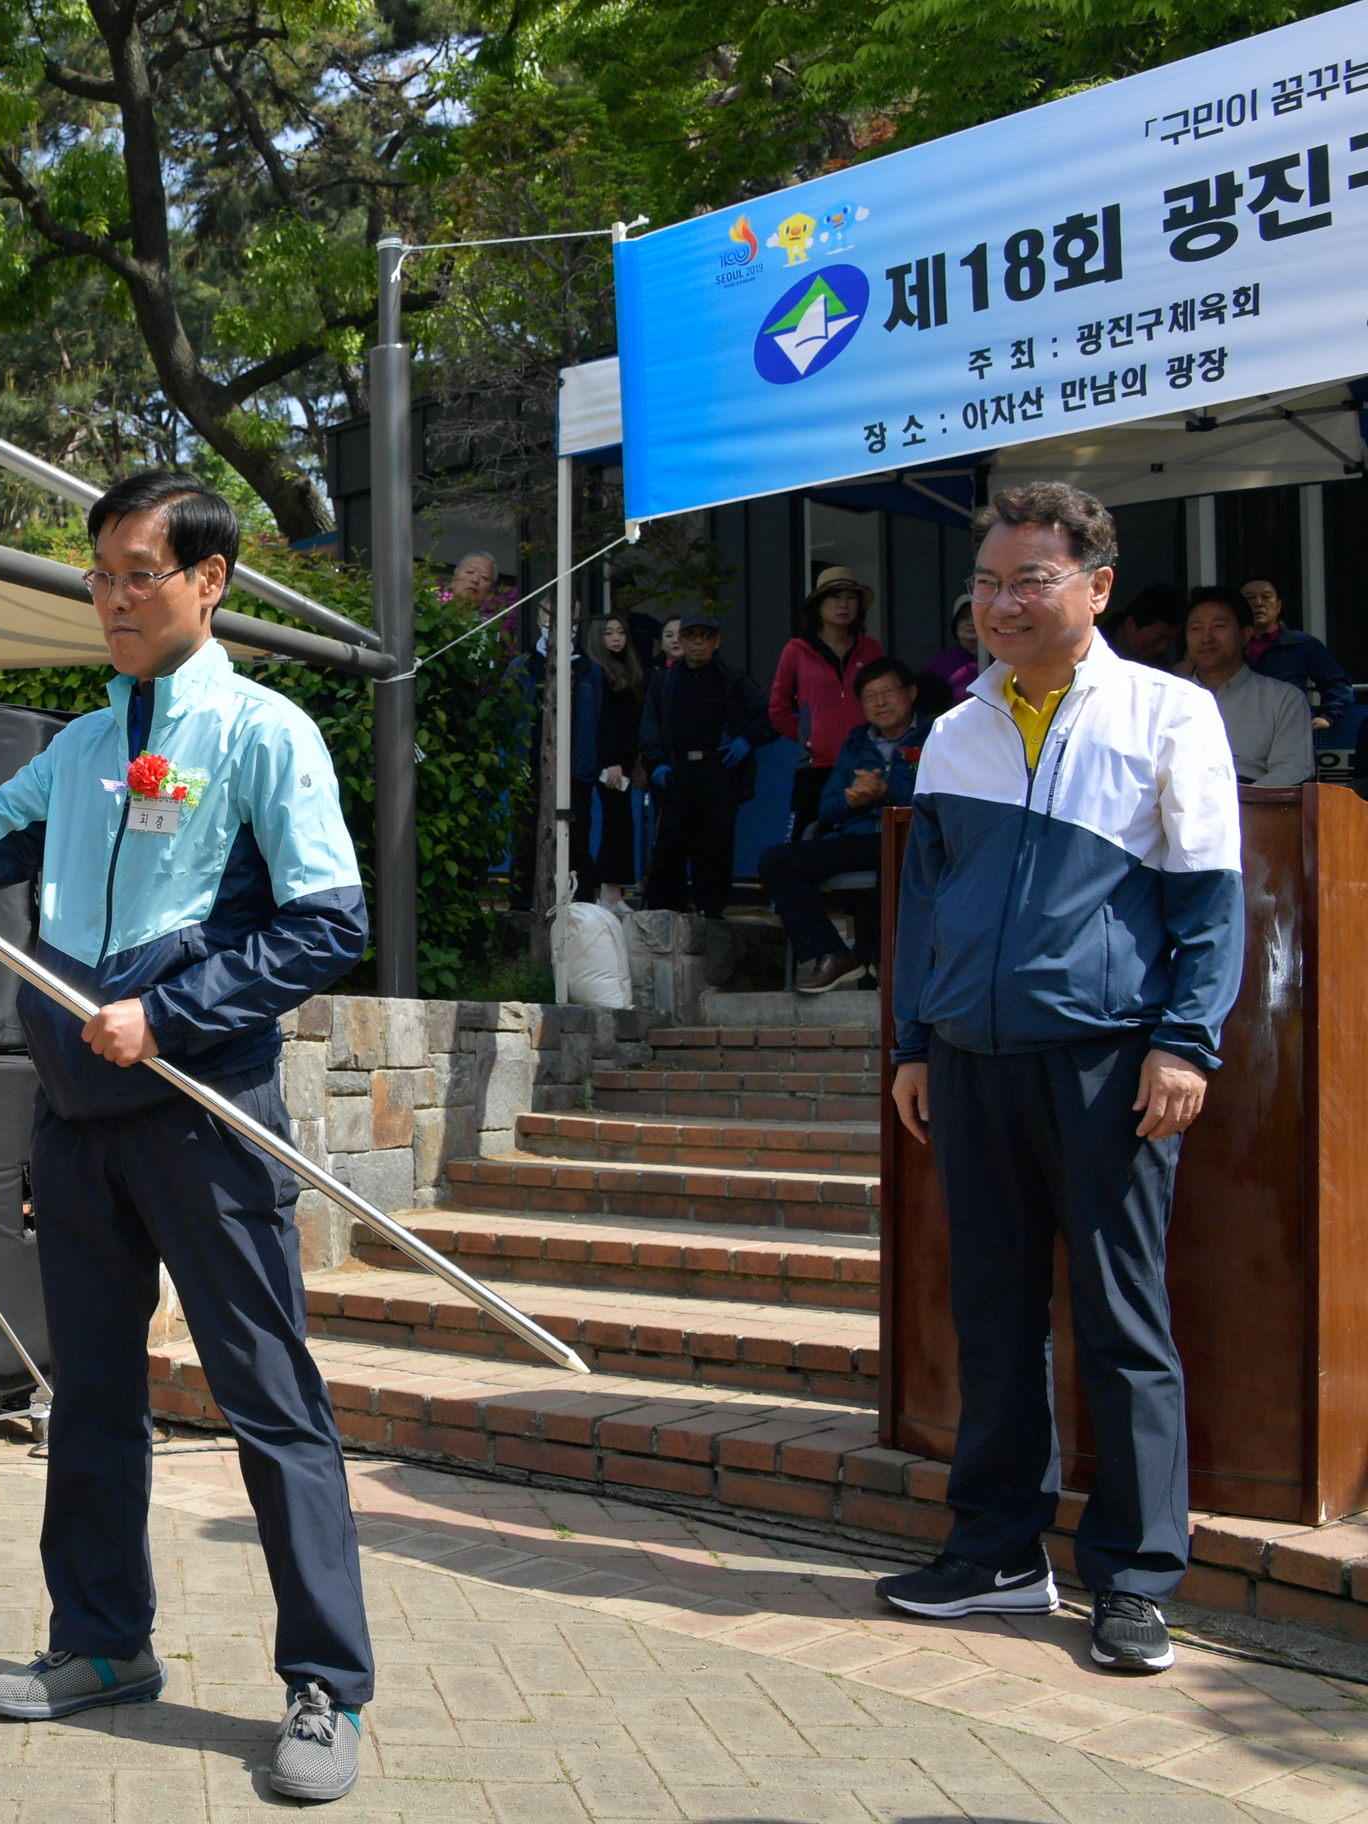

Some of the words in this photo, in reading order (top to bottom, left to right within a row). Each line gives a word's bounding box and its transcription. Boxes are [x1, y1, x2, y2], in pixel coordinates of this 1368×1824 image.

[1271, 58, 1368, 117] 꿈꾸는
[882, 203, 1123, 333] 제18회
[1162, 132, 1368, 263] 광진
[715, 269, 744, 285] SEOUL
[745, 262, 764, 277] 2019
[1076, 282, 1261, 356] 광진구체육회
[962, 387, 1044, 432] 아차산
[1061, 364, 1148, 413] 만남의
[1165, 346, 1228, 389] 광장
